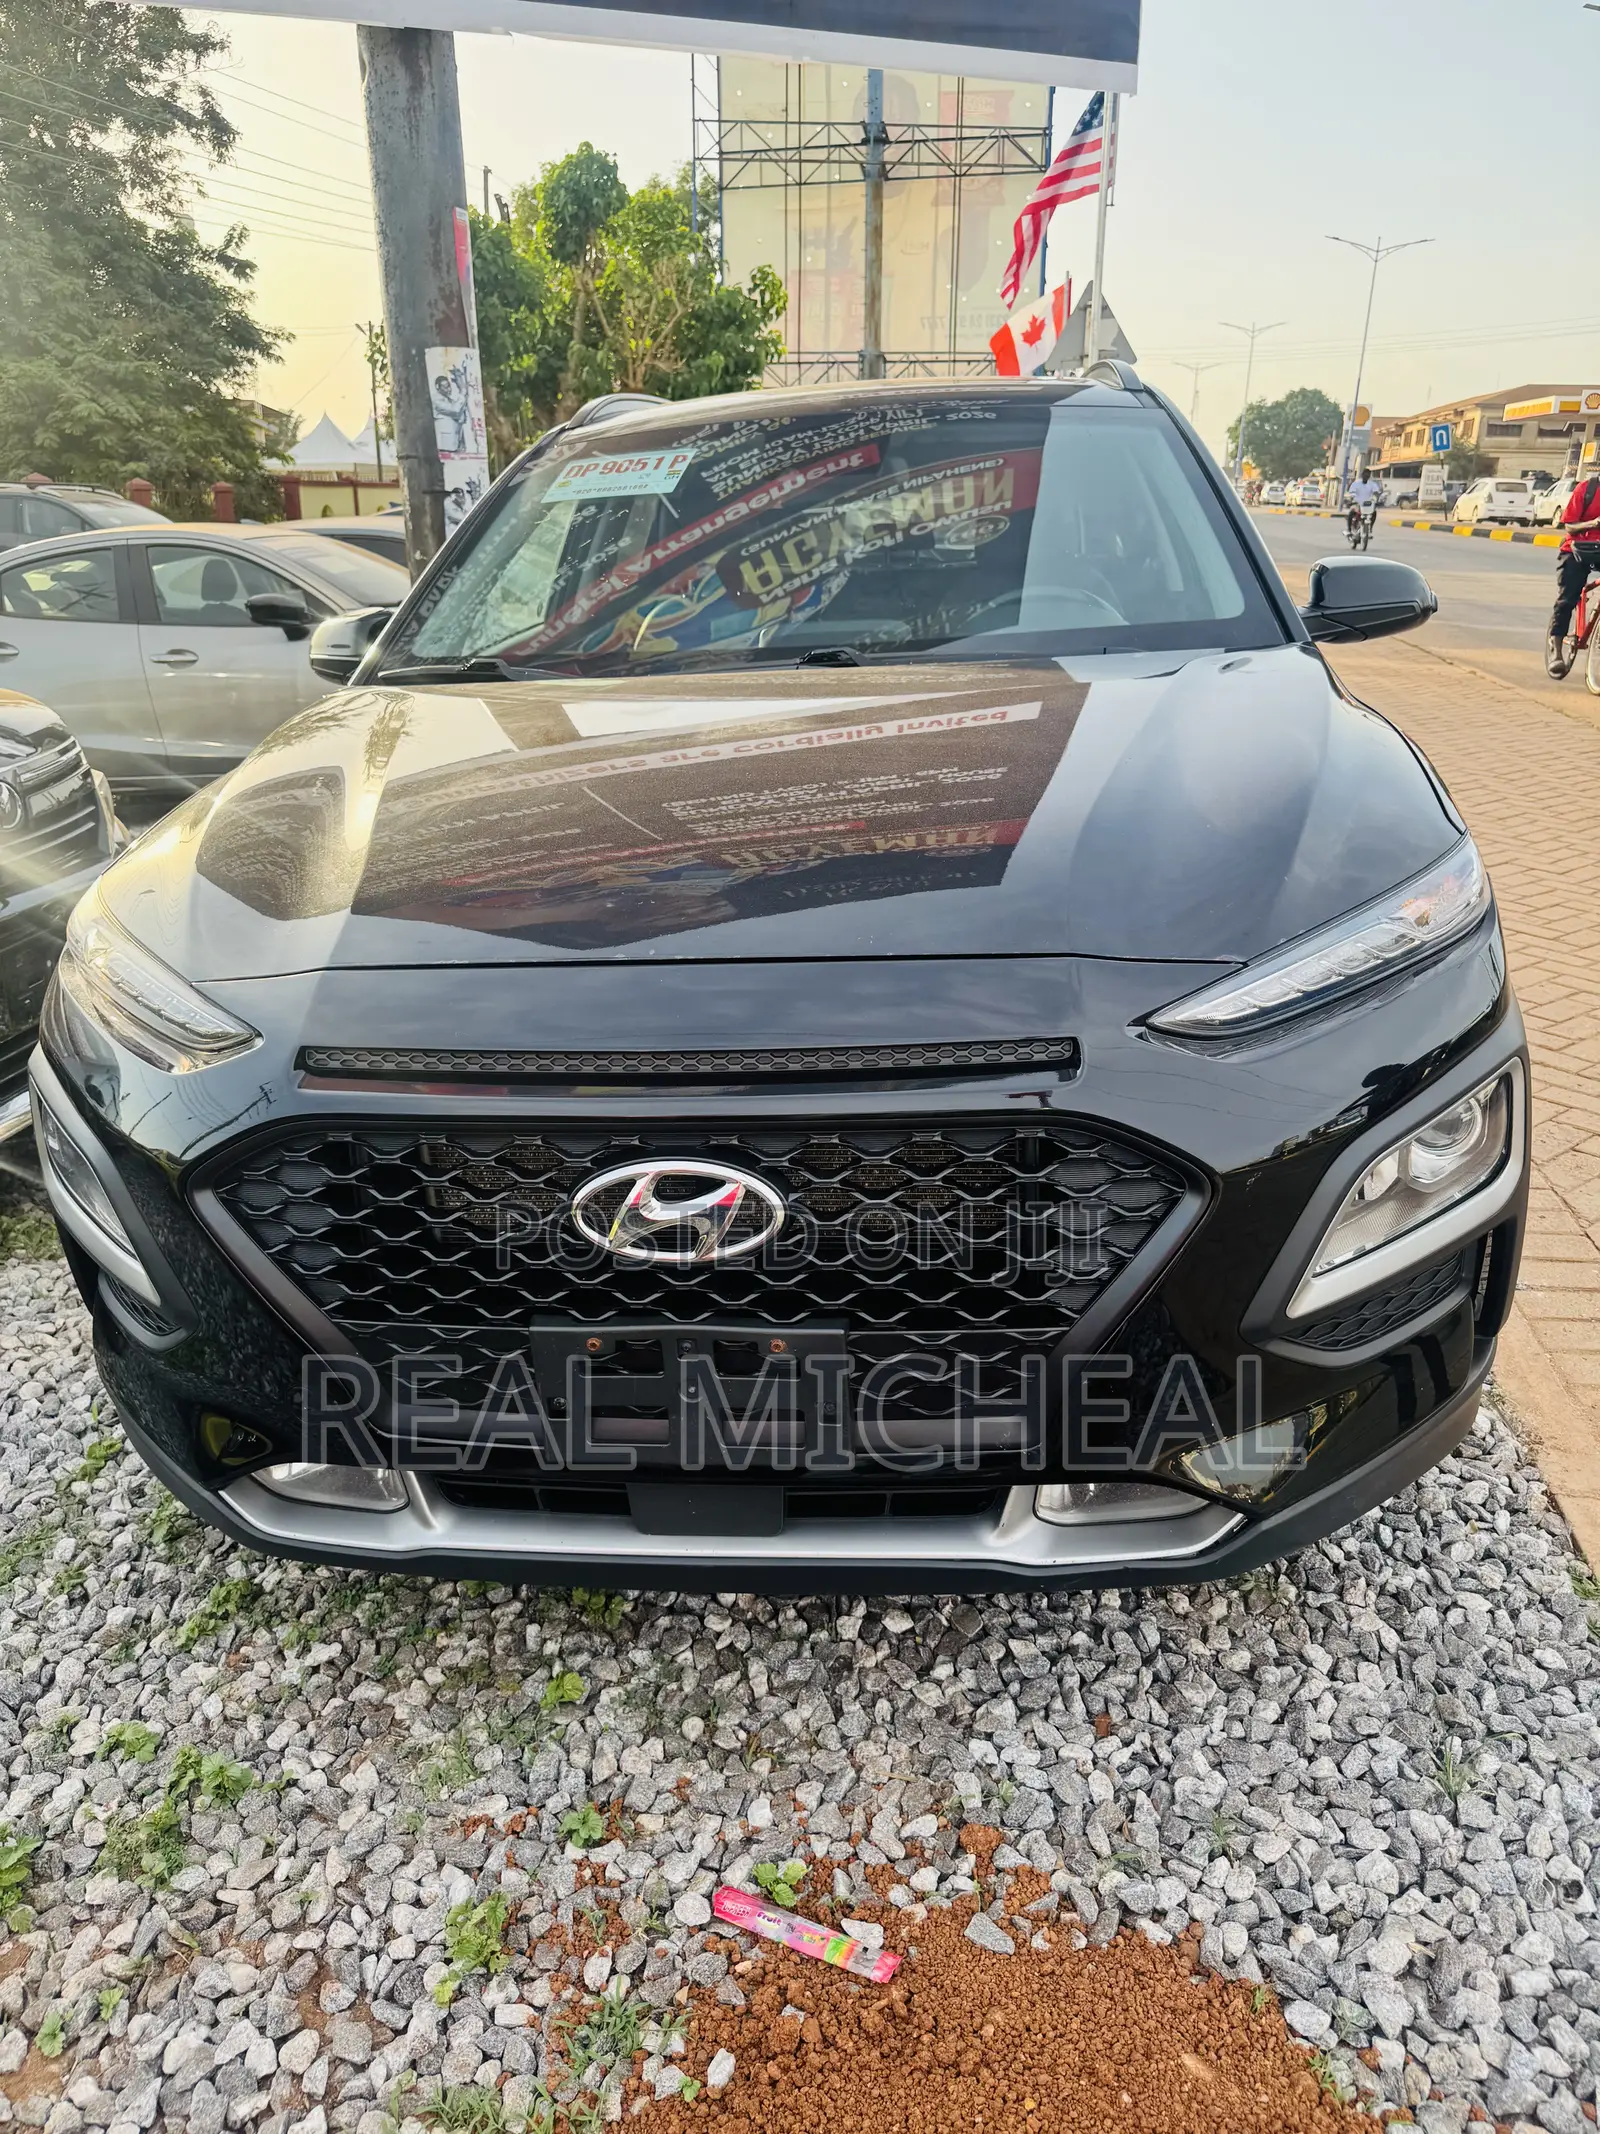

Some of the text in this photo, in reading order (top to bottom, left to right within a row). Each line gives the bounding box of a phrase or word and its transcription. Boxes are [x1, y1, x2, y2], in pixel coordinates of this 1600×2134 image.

[563, 454, 689, 479] DP 9051 P
[756, 1911, 782, 1925] Fruit
